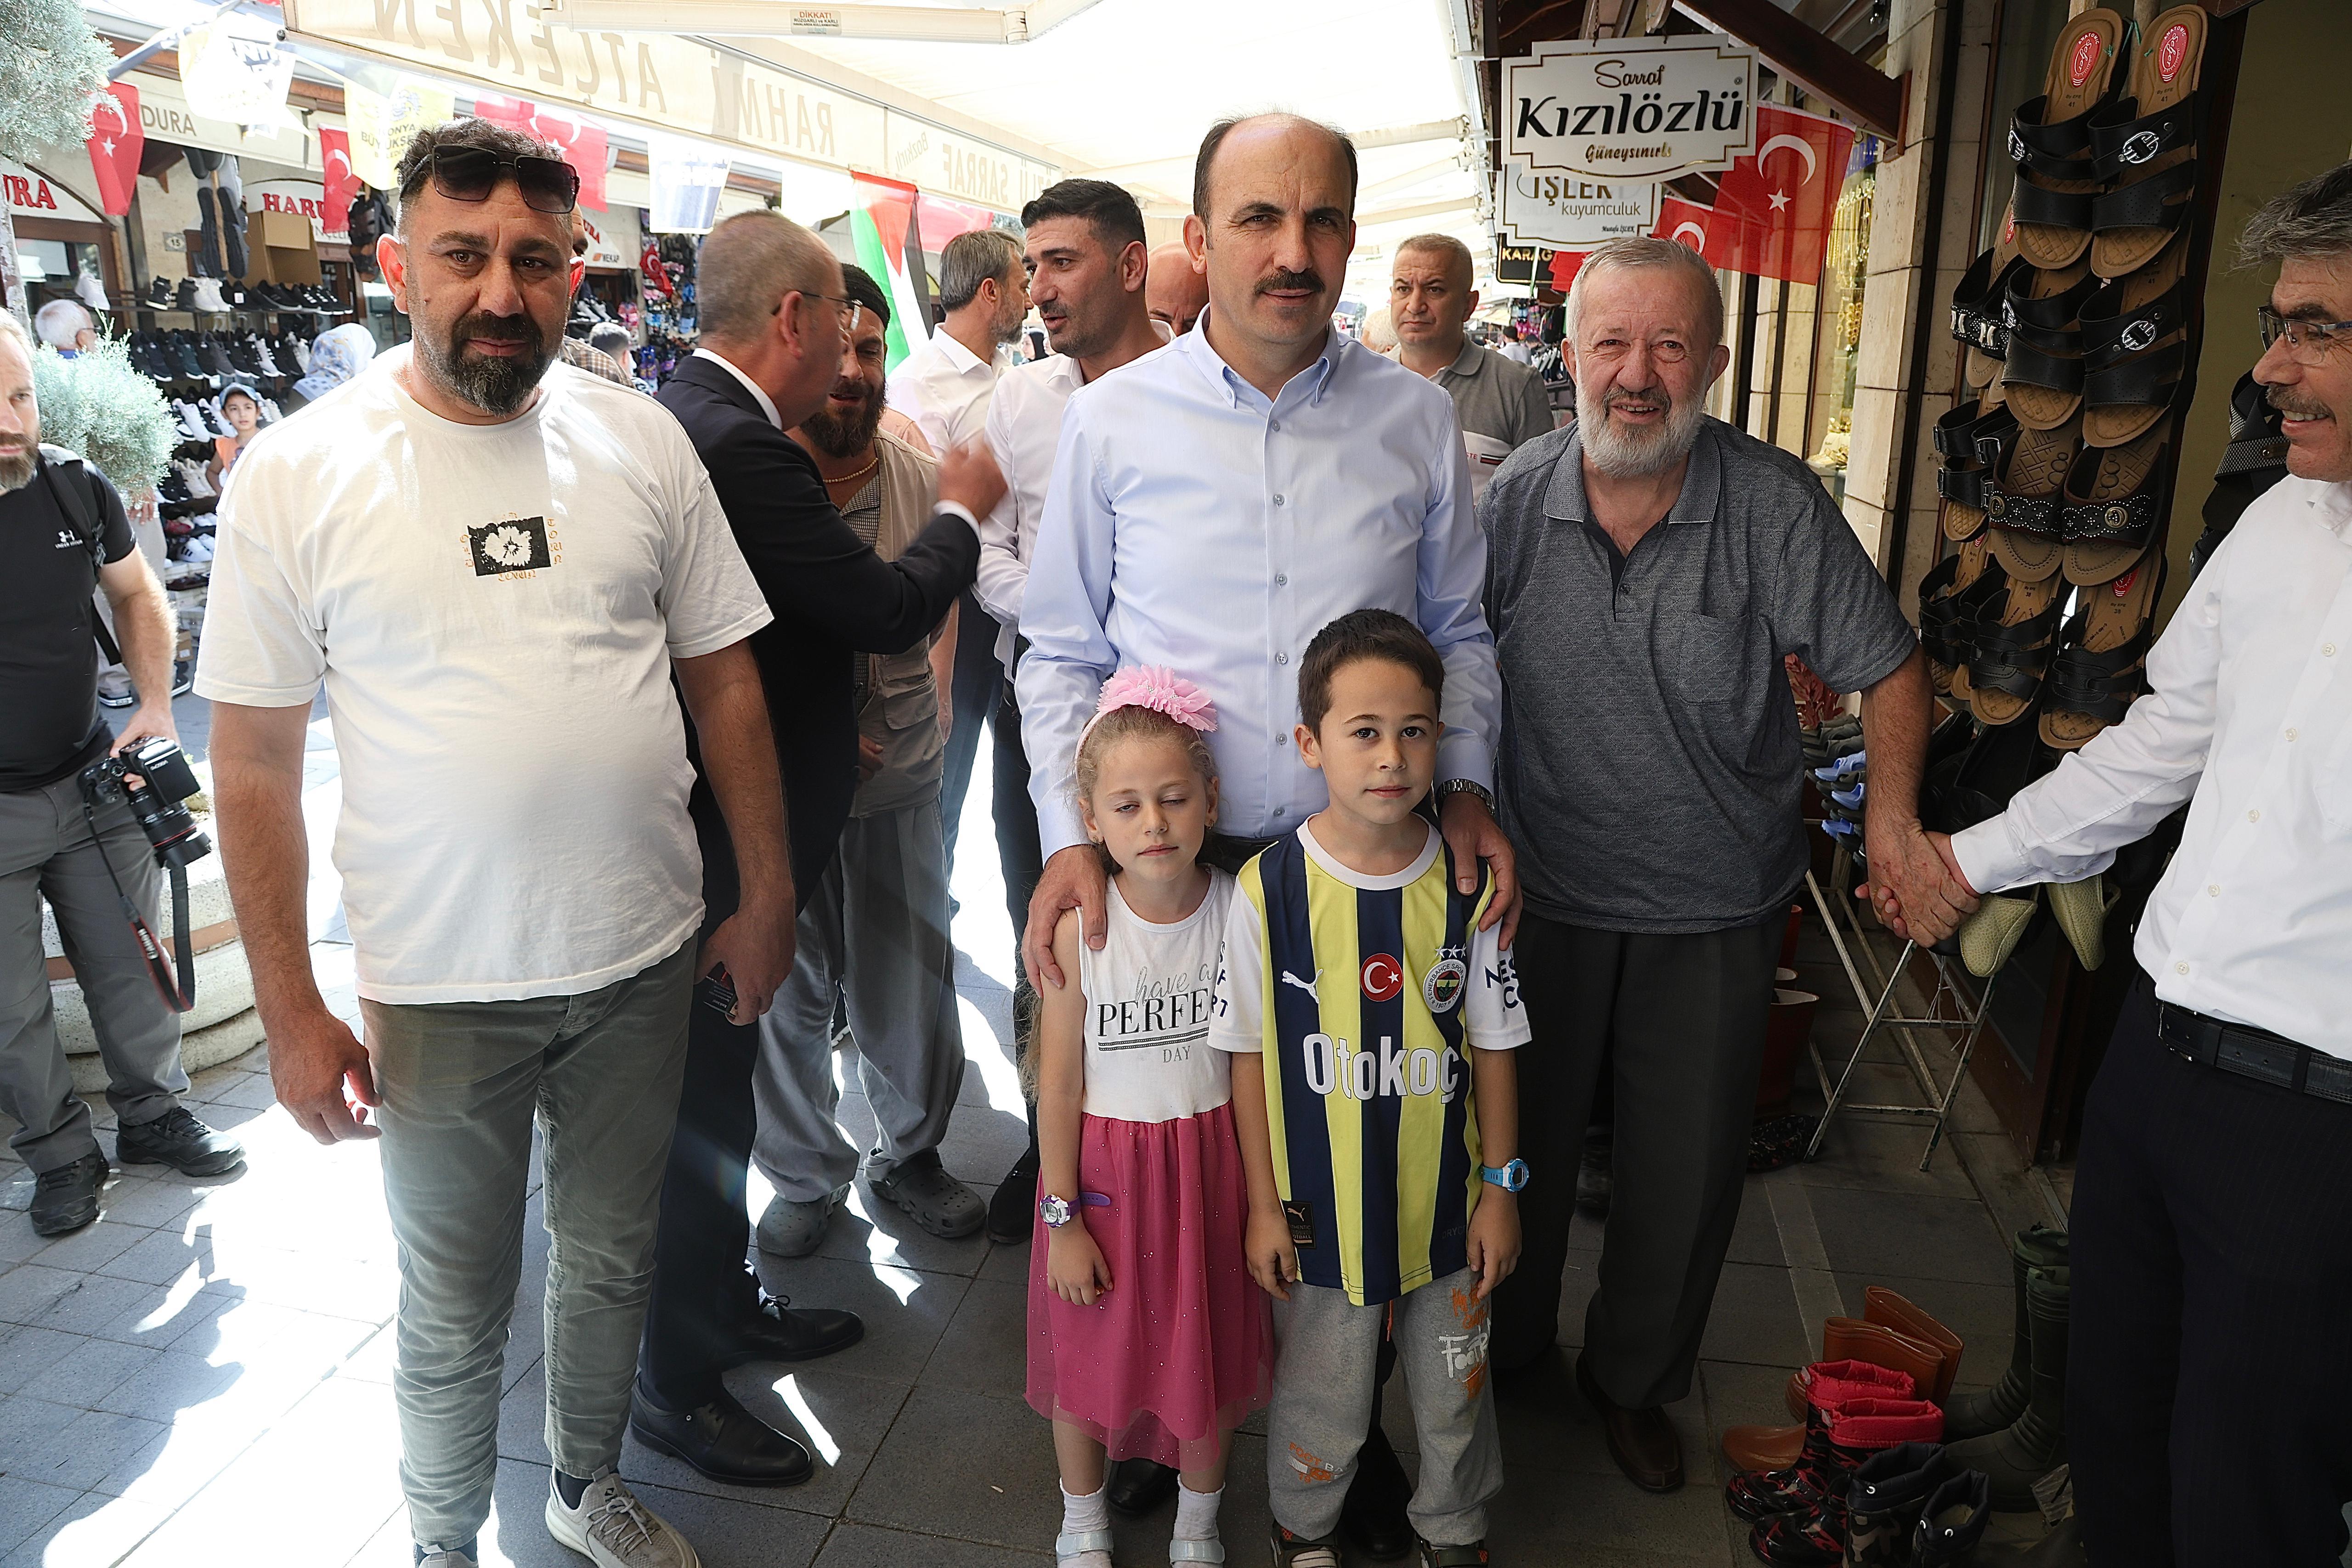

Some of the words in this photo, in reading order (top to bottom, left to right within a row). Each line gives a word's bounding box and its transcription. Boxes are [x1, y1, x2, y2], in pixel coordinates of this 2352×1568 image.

[2078, 33, 2100, 45] ANATOMIC
[2164, 26, 2186, 40] ANATOMIC
[1594, 60, 1665, 88] Sarraf
[1517, 90, 1743, 138] Kızılözlü
[1562, 201, 1640, 220] kuyumculuk
[1135, 966, 1189, 1006] have
[1199, 963, 1214, 981] a
[1428, 964, 1450, 1000] FENERBAHÇE
[1451, 963, 1464, 976] SPOR
[1097, 987, 1210, 1037] PERFE
[1163, 1045, 1191, 1063] DAY
[1303, 1032, 1460, 1104] Otokoç
